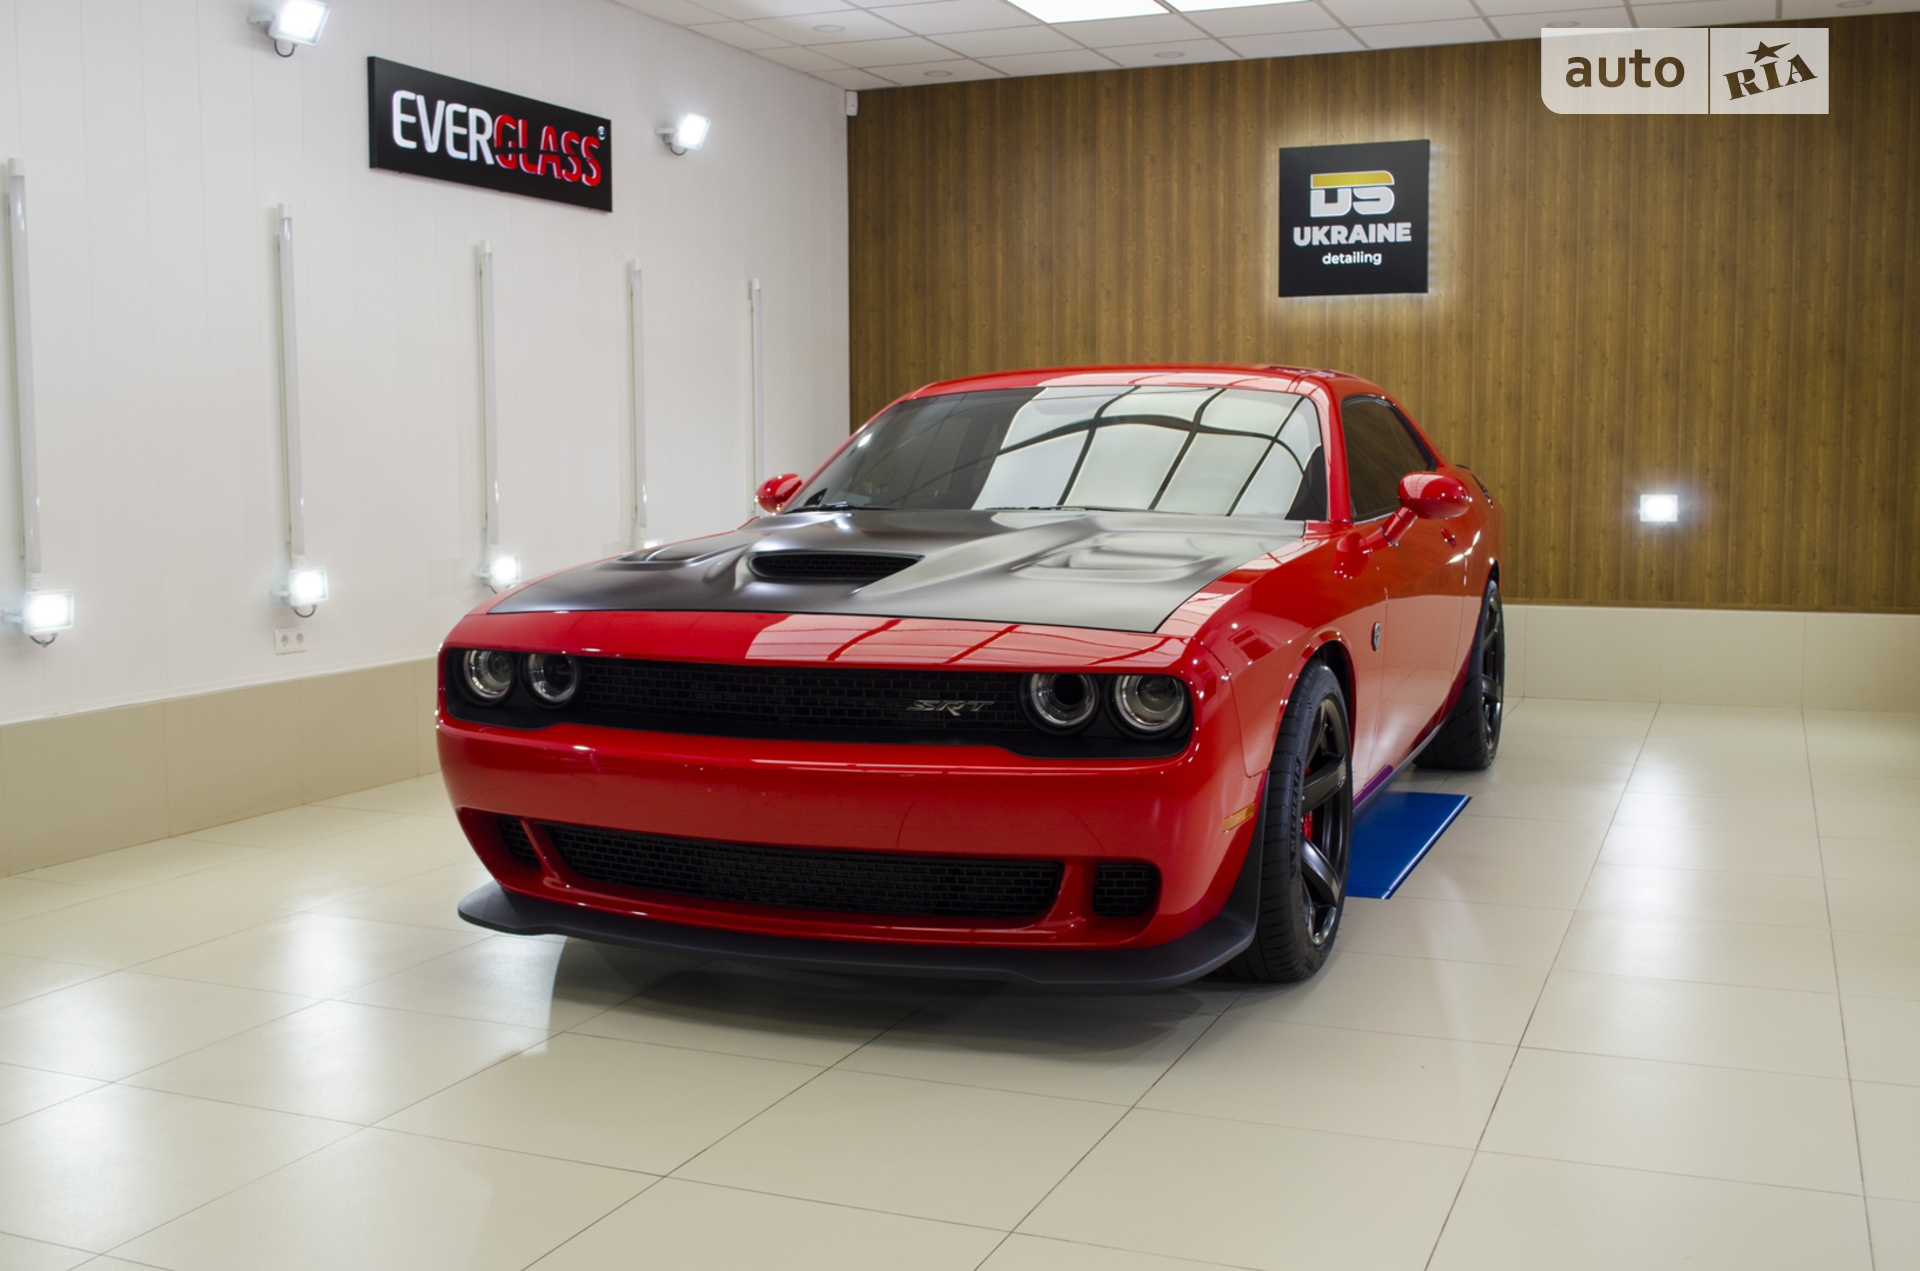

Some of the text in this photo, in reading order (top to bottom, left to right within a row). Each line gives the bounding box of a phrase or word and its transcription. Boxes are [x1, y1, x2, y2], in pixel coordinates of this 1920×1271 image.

[392, 90, 602, 187] EVERGLASS
[1293, 222, 1412, 246] UKRAINE
[1322, 251, 1382, 265] detailing
[906, 700, 994, 716] SRT
